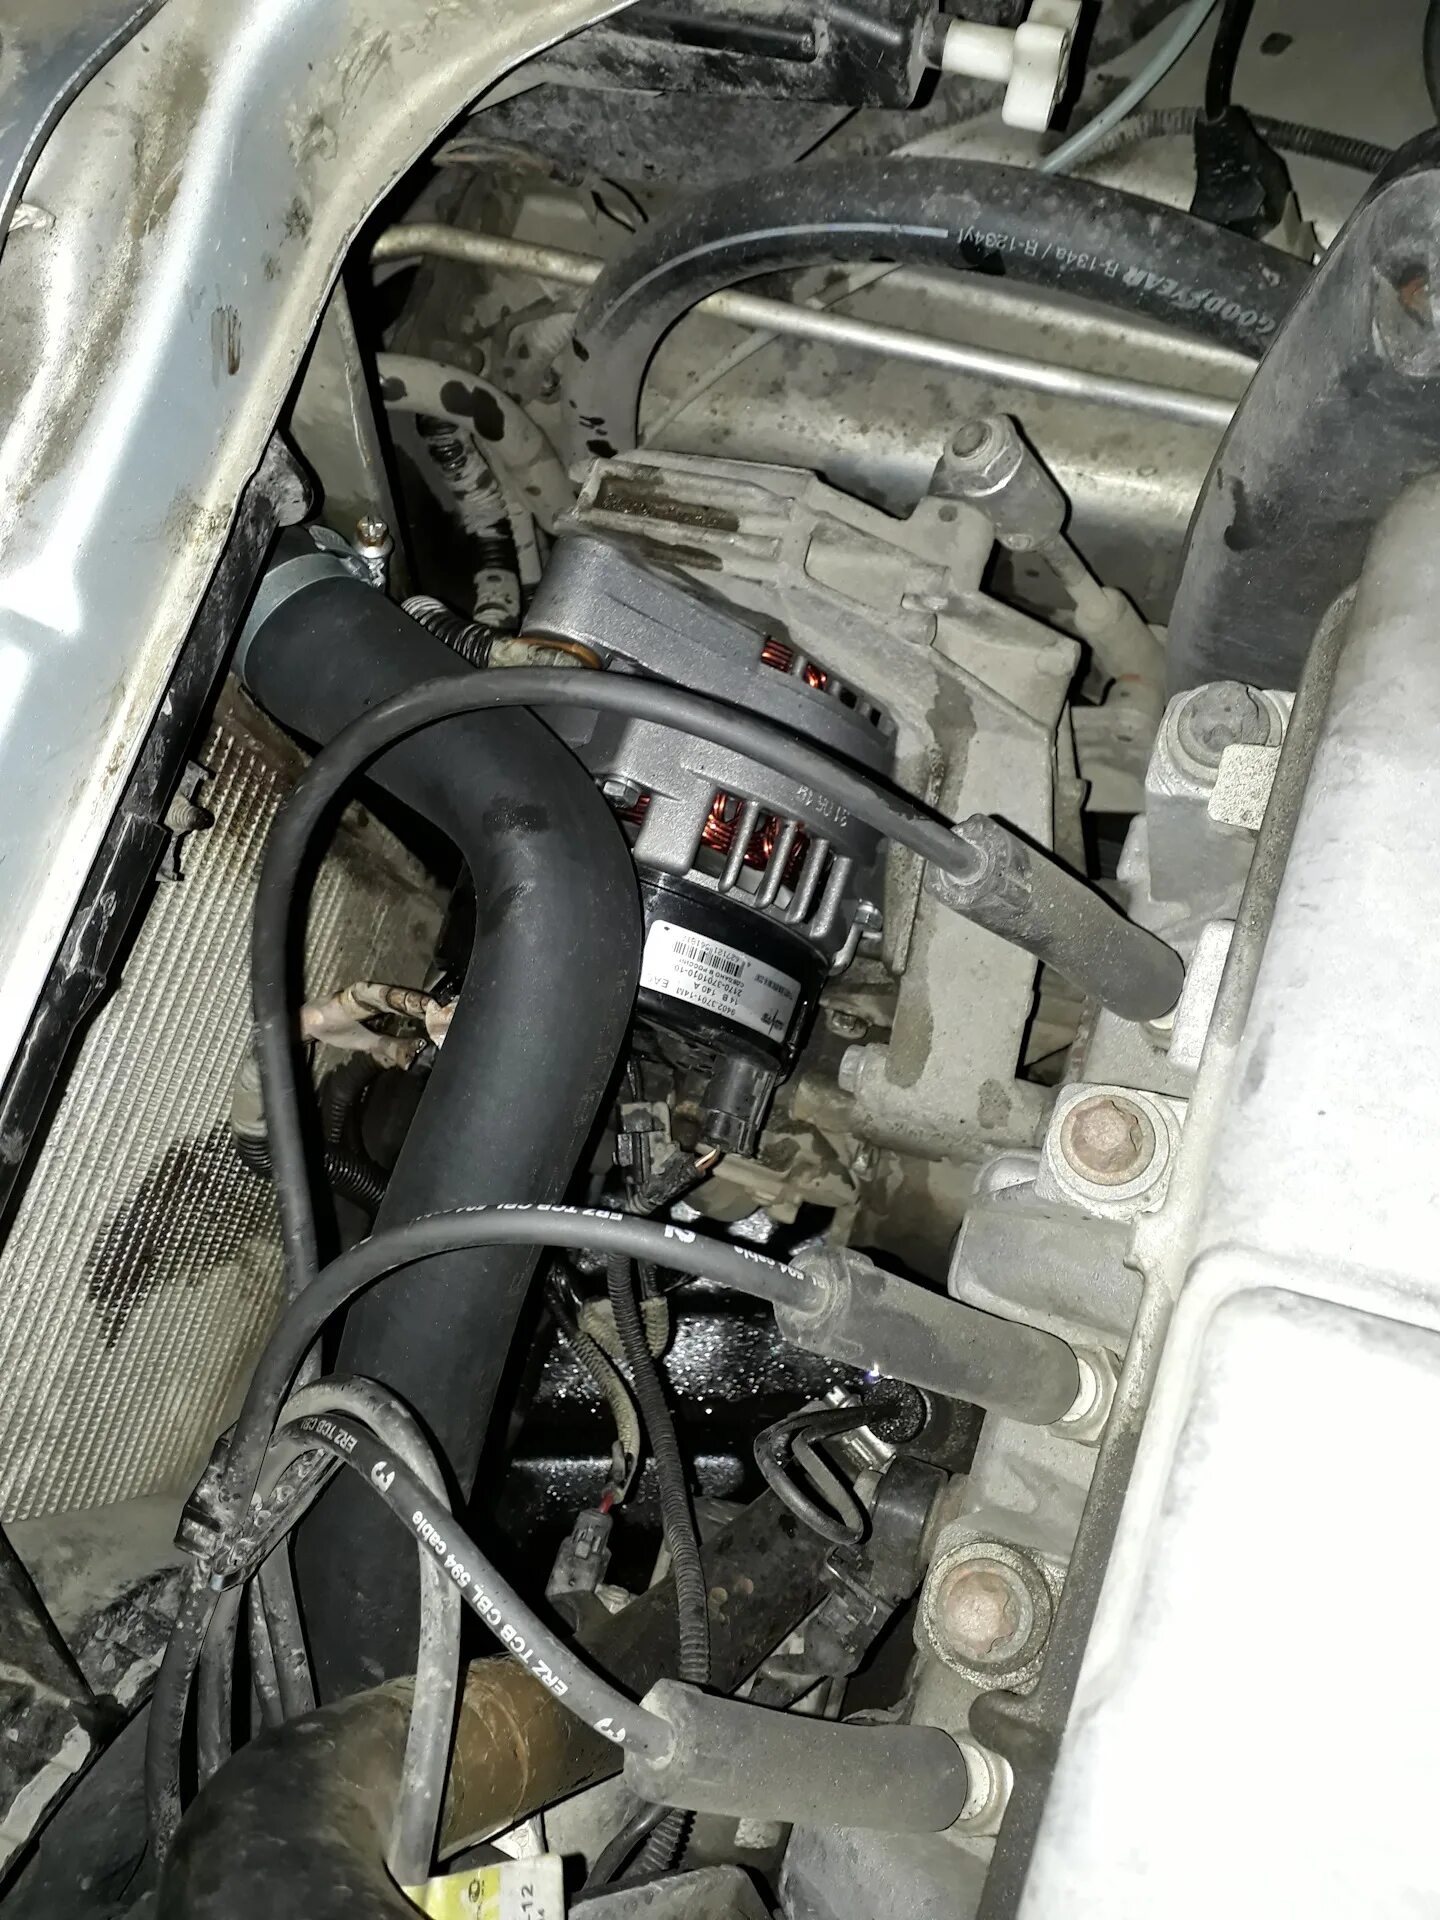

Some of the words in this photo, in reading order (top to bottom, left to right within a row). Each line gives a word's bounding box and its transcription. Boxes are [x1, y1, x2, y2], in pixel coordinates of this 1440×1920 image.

[1055, 251, 1119, 278] R-134a
[1122, 264, 1276, 334] GOODYEAR
[315, 1420, 337, 1440] TCB
[334, 1428, 358, 1454] ERZ
[412, 1510, 447, 1556] cable
[444, 1553, 471, 1588] 594
[471, 1583, 502, 1626] CBL
[500, 1623, 534, 1665] TCB
[531, 1659, 569, 1697] ERZ
